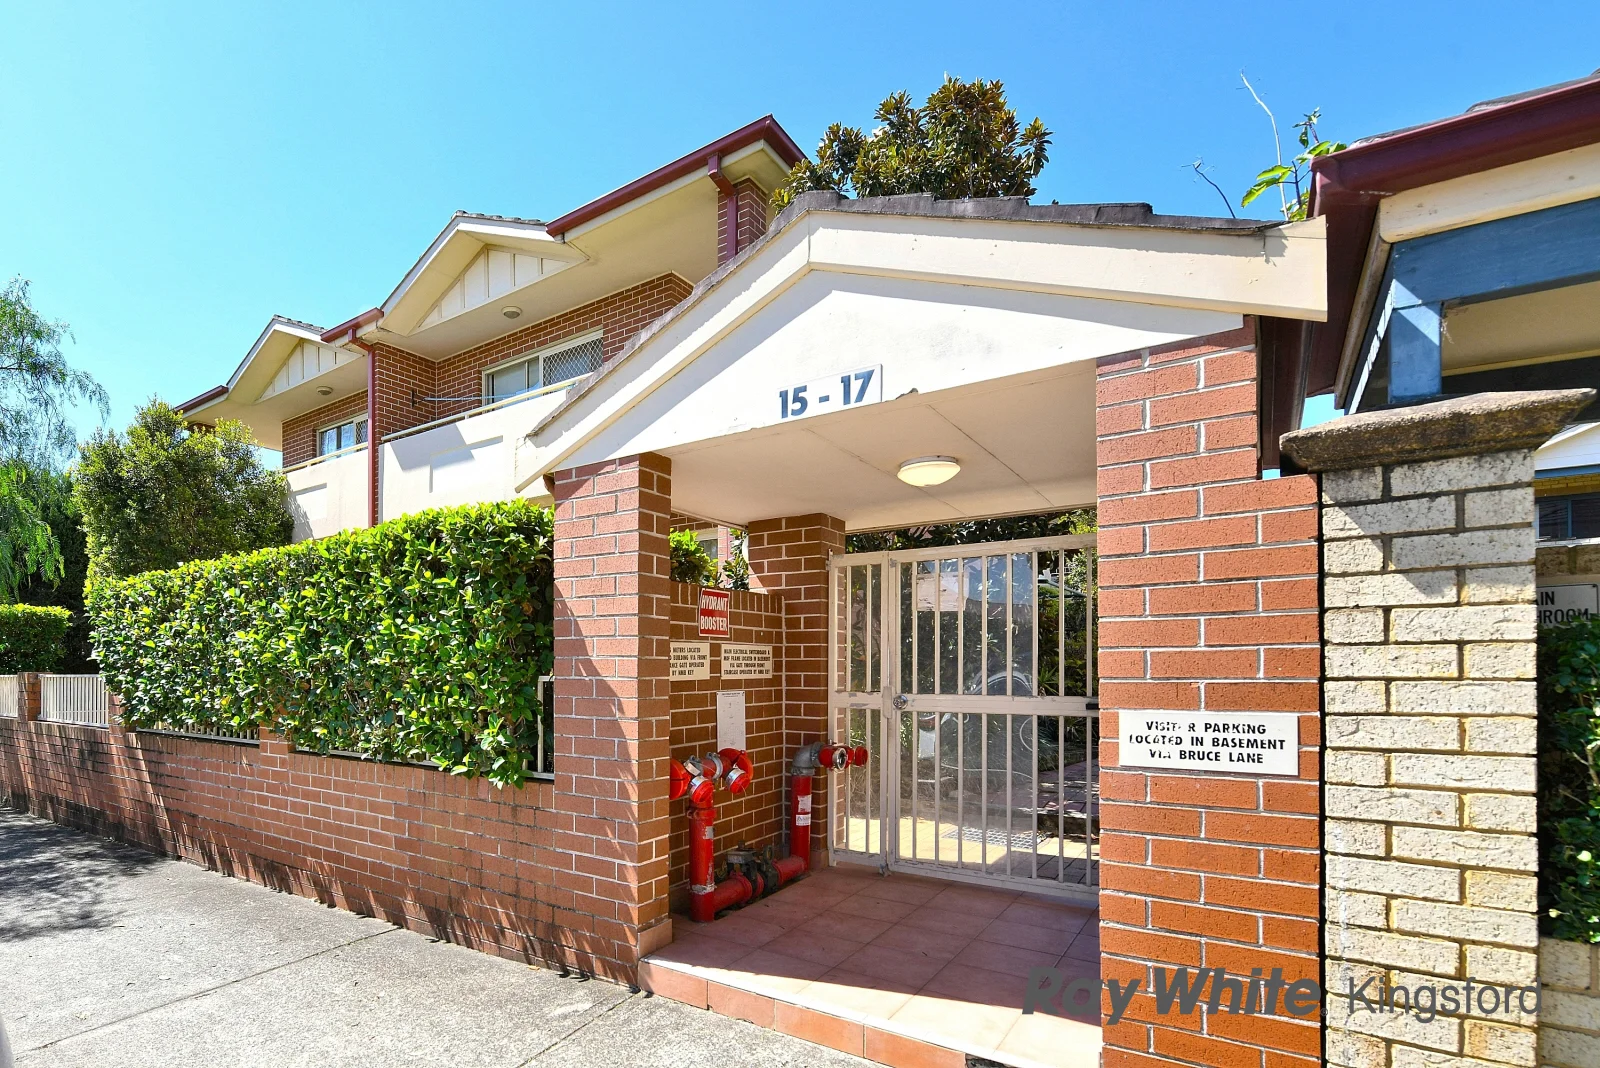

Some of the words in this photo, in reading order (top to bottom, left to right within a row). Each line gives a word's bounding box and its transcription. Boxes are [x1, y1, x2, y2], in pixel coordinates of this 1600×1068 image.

[779, 385, 808, 419] 15
[841, 369, 875, 406] 17
[701, 595, 728, 611] HYDRANT
[700, 616, 727, 631] BOOSTER
[1204, 722, 1267, 735] PARKING
[1129, 734, 1183, 746] LOCATED
[1191, 737, 1204, 747] IN
[1211, 738, 1286, 750] BASEMENT
[1179, 750, 1221, 762] BRUCE
[1229, 752, 1264, 764] LANE
